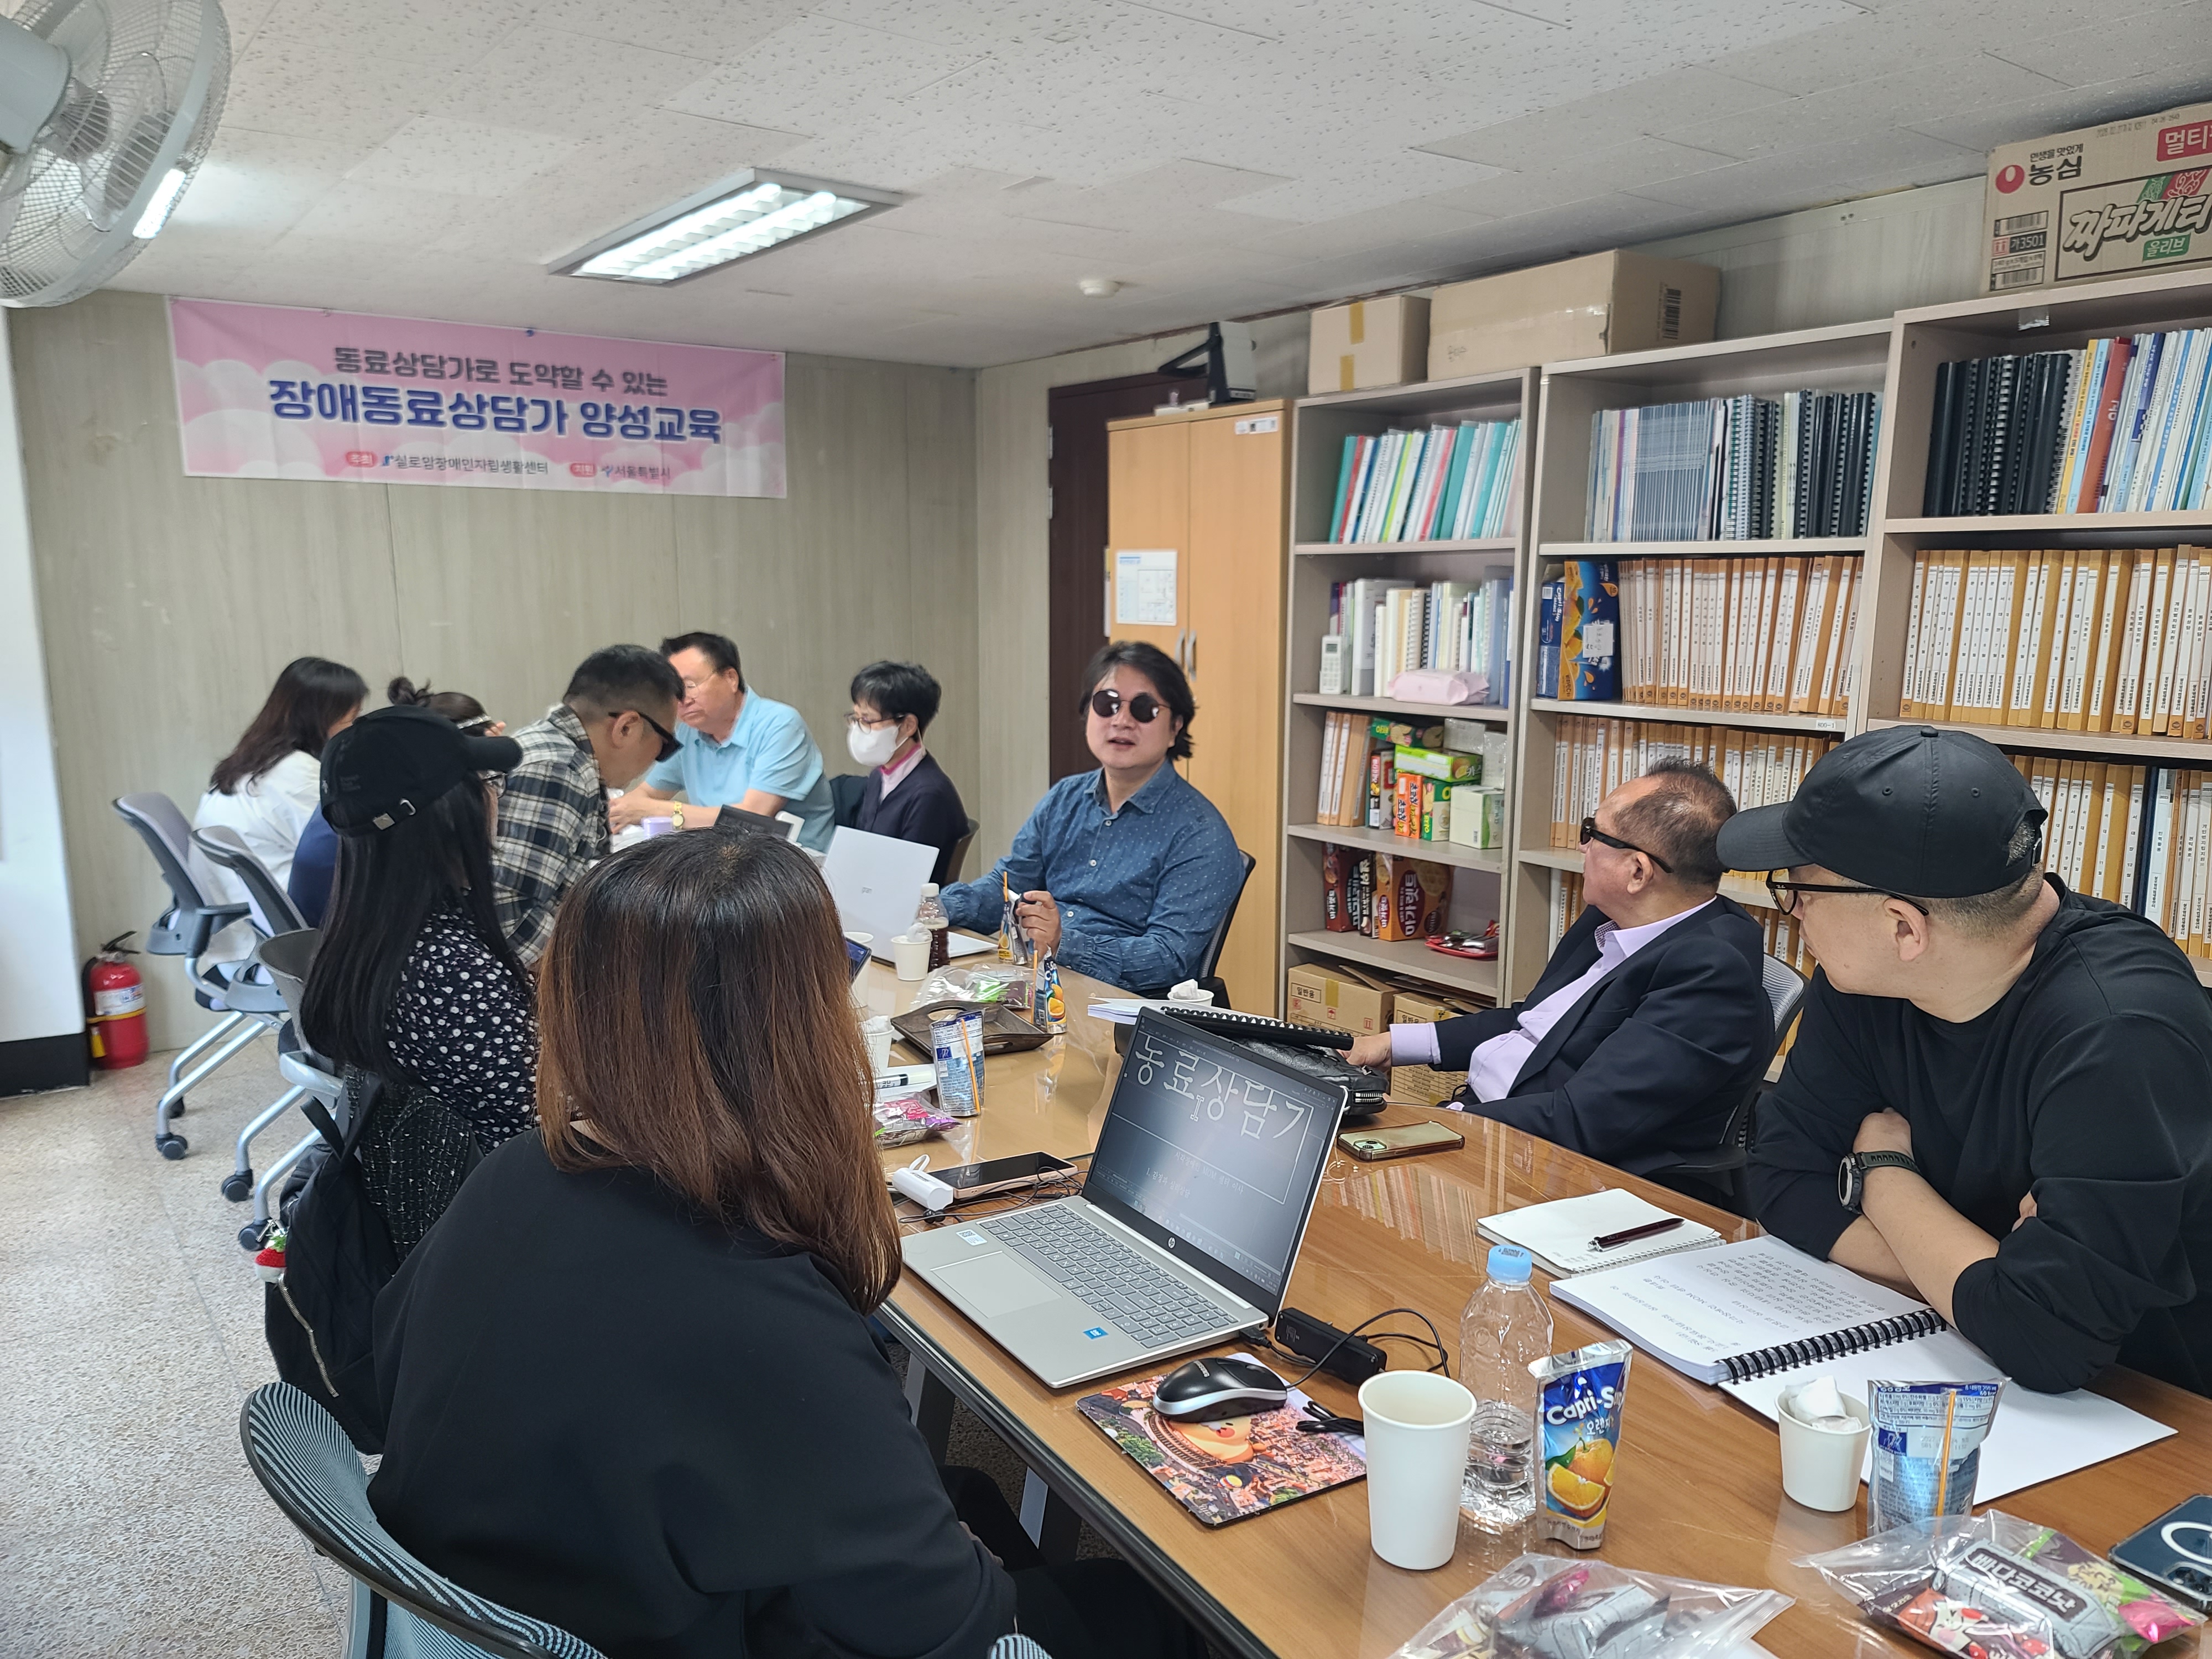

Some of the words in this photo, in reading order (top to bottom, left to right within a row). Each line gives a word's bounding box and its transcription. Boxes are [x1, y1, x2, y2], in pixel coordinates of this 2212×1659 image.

[2164, 125, 2212, 155] 멀티
[2028, 155, 2083, 186] 농심
[2147, 237, 2186, 258] 올리브
[333, 347, 500, 386] 동료상담가로
[509, 361, 585, 392] 도약할
[591, 367, 614, 392] 수
[623, 371, 669, 397] 있는
[268, 378, 569, 436] 장애동료상담가
[581, 401, 722, 444] 양성교육
[395, 455, 549, 474] 실로암장애인자립생활센터
[614, 465, 671, 480] 서울특별시
[1405, 874, 1419, 936] 마가렛트
[1296, 986, 1316, 999] 일반용
[1971, 1552, 2077, 1615] 빠다코코낫
